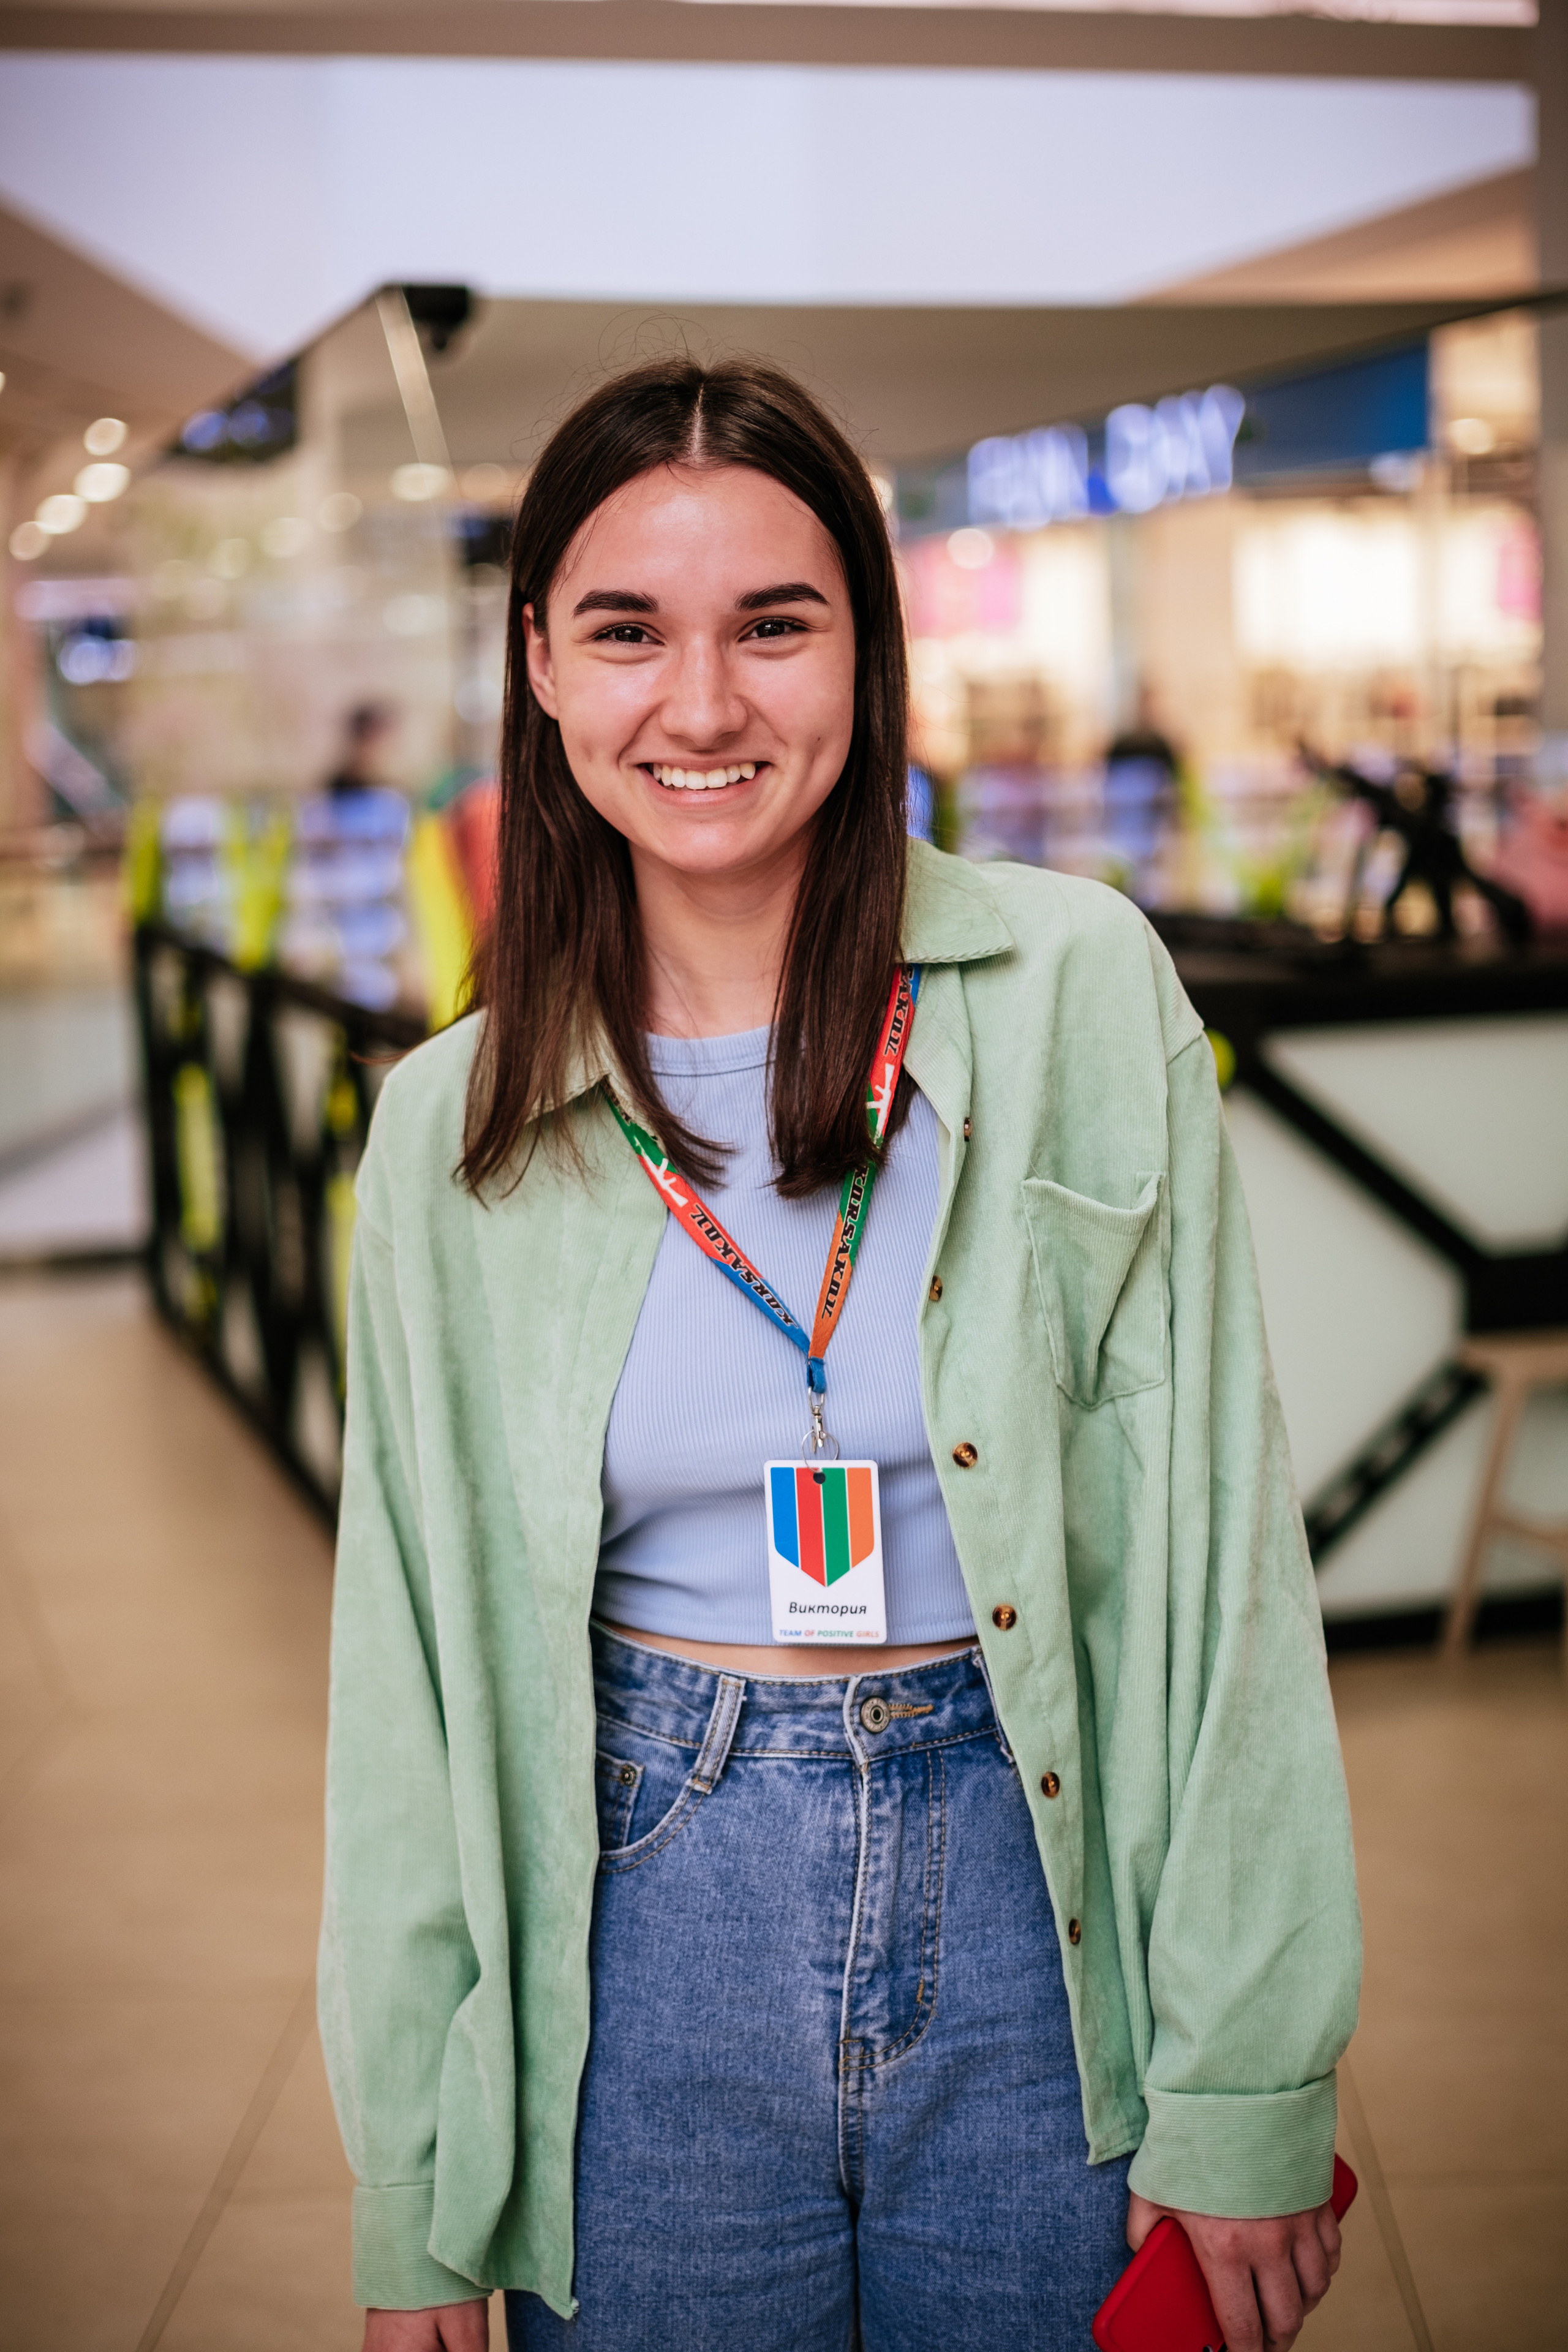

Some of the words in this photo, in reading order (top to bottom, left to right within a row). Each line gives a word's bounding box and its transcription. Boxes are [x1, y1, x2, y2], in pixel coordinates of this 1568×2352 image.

[690, 1205, 798, 1328] KORSAKOV
[822, 1165, 869, 1319] KORSAKOV
[789, 1602, 867, 1616] Виктория
